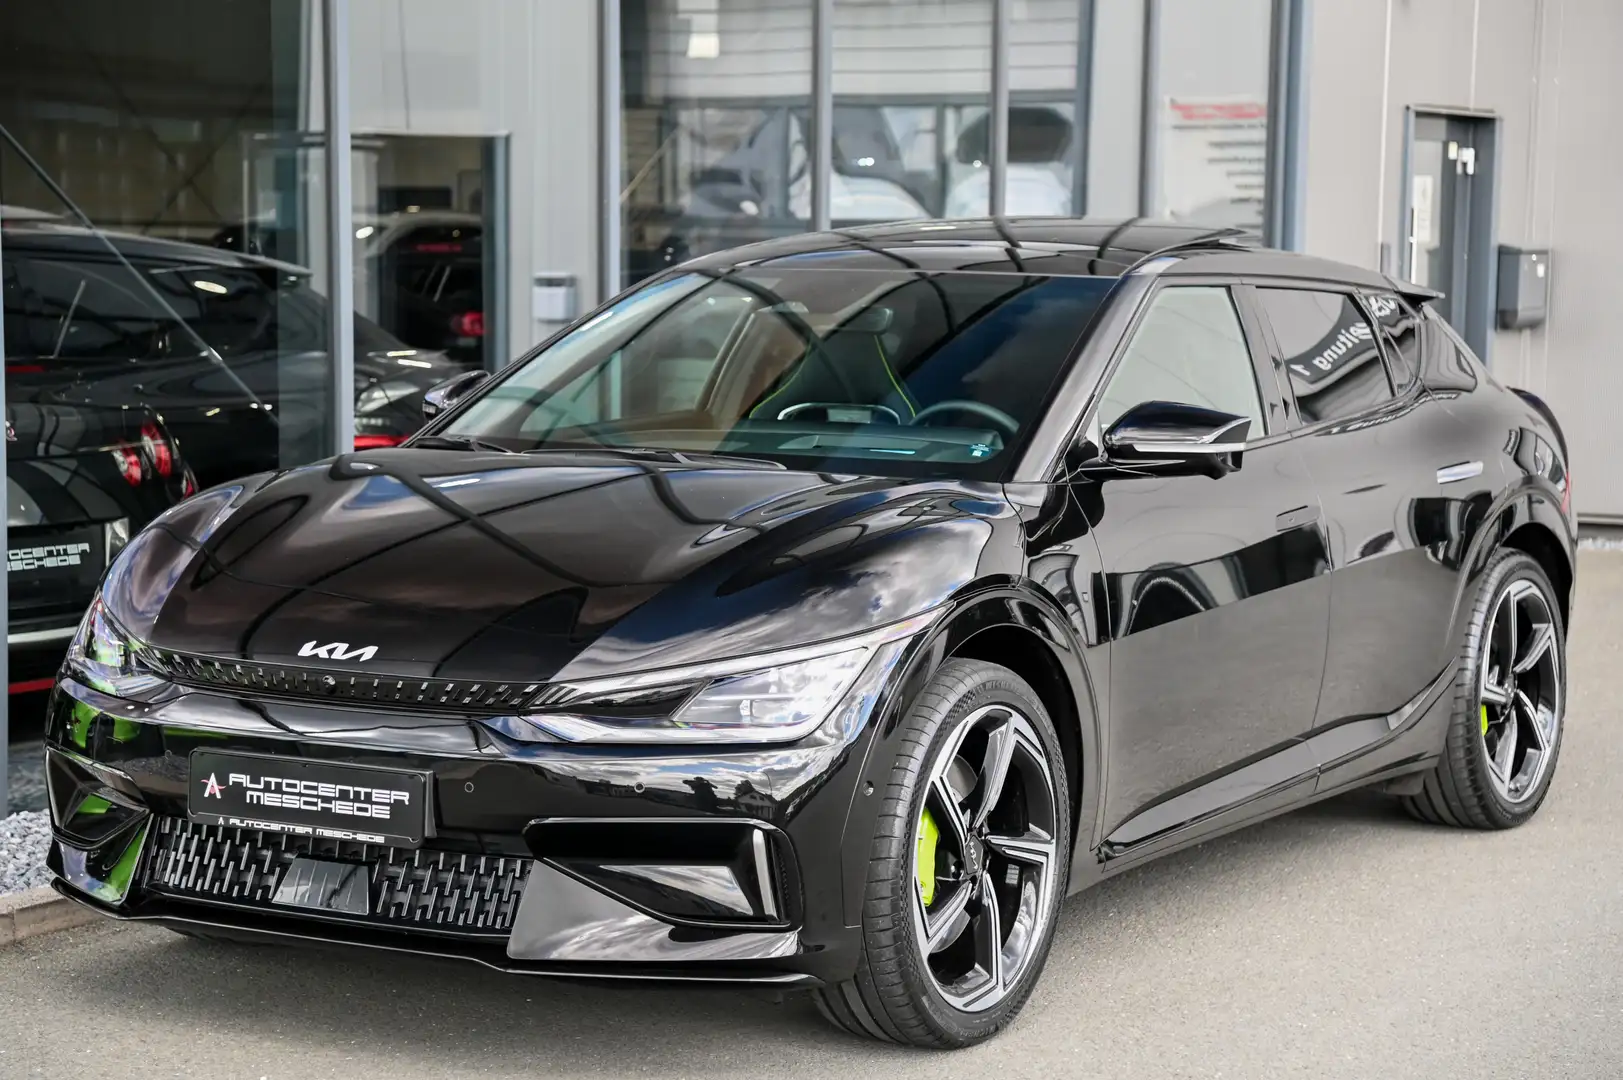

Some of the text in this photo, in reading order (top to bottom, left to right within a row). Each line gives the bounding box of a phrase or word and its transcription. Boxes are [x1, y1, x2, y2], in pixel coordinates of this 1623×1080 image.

[7, 543, 90, 560] OCENTER
[298, 640, 379, 662] KIA
[229, 773, 410, 805] AUTOCENTER
[246, 790, 391, 819] MESCHEDE
[229, 818, 313, 835] AUTOCENTER
[316, 828, 385, 844] MESCHEDE
